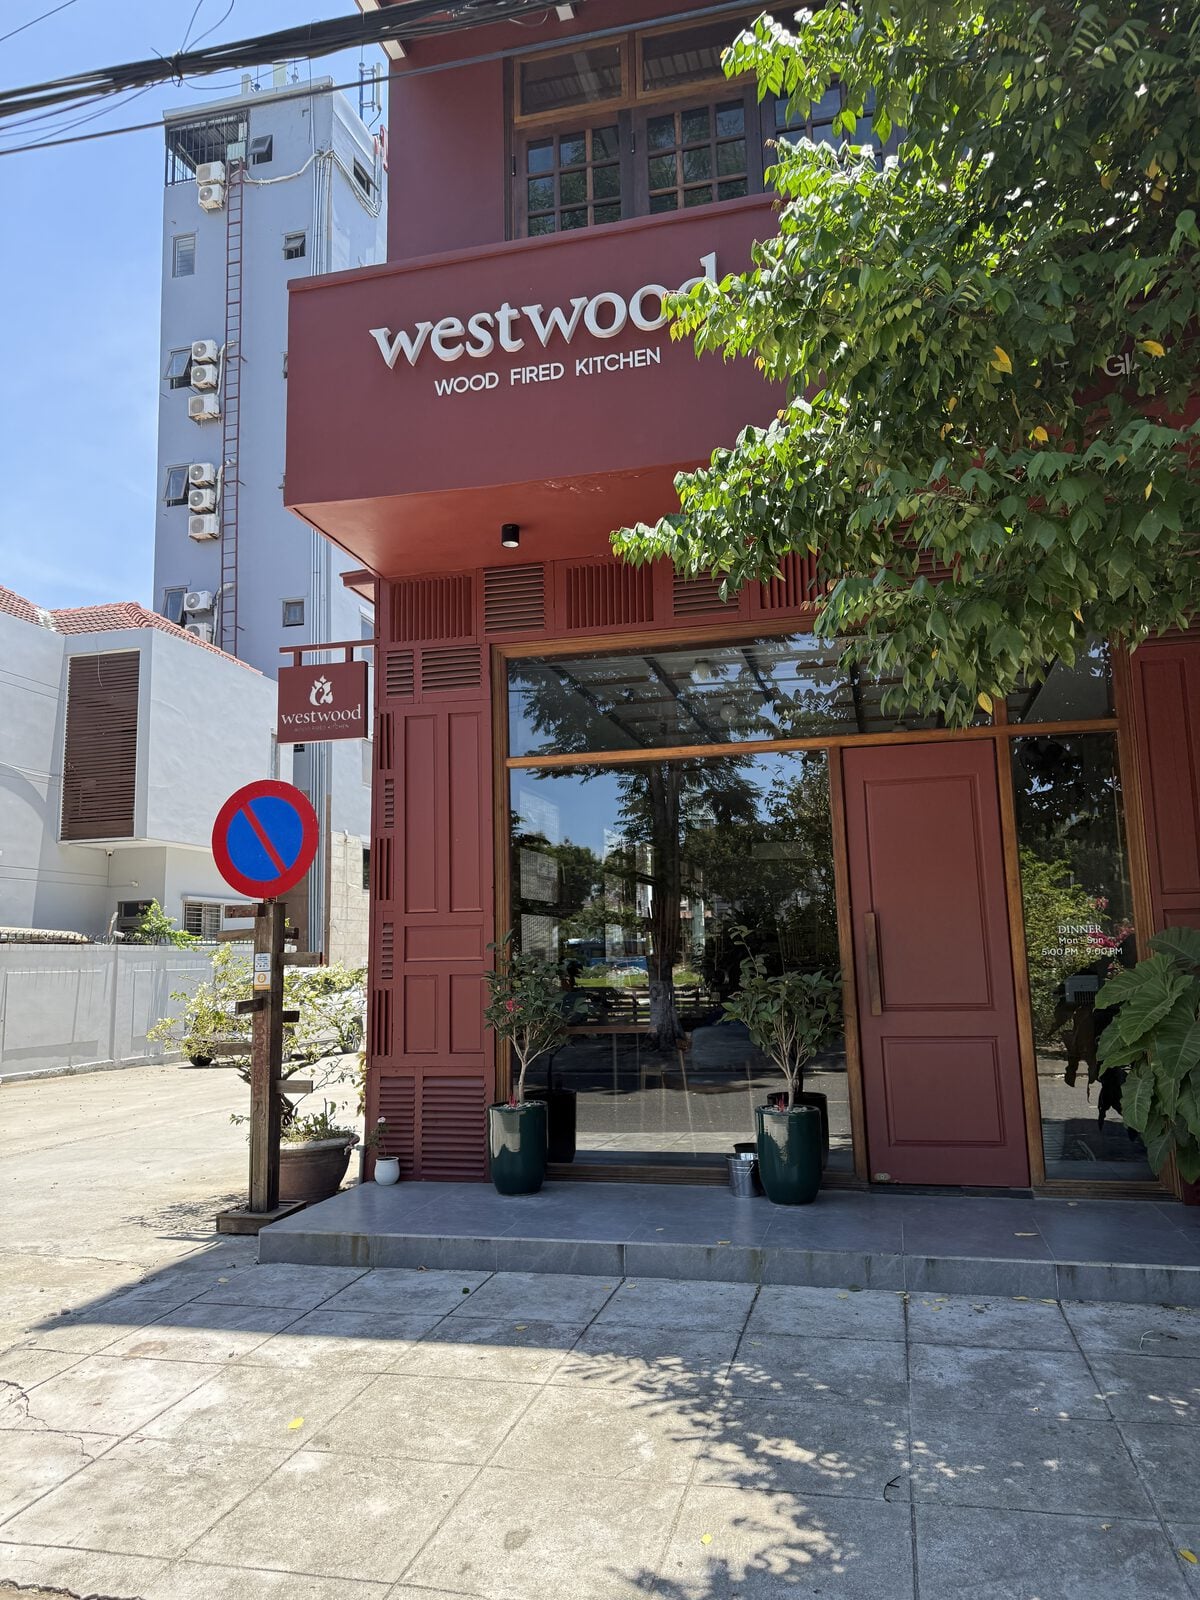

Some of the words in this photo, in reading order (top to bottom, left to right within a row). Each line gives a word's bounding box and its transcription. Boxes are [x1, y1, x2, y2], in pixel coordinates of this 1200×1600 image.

[434, 372, 500, 397] WOOD
[510, 362, 566, 386] FIRED
[575, 346, 662, 377] KITCHEN
[281, 703, 361, 724] westwood
[1058, 924, 1103, 934] DINNER
[1058, 936, 1078, 944] Mon
[1087, 936, 1104, 944] Sun
[1041, 947, 1063, 956] 5:00
[1064, 947, 1079, 956] PM
[1086, 947, 1108, 956] 9:00
[1109, 947, 1123, 955] PM
